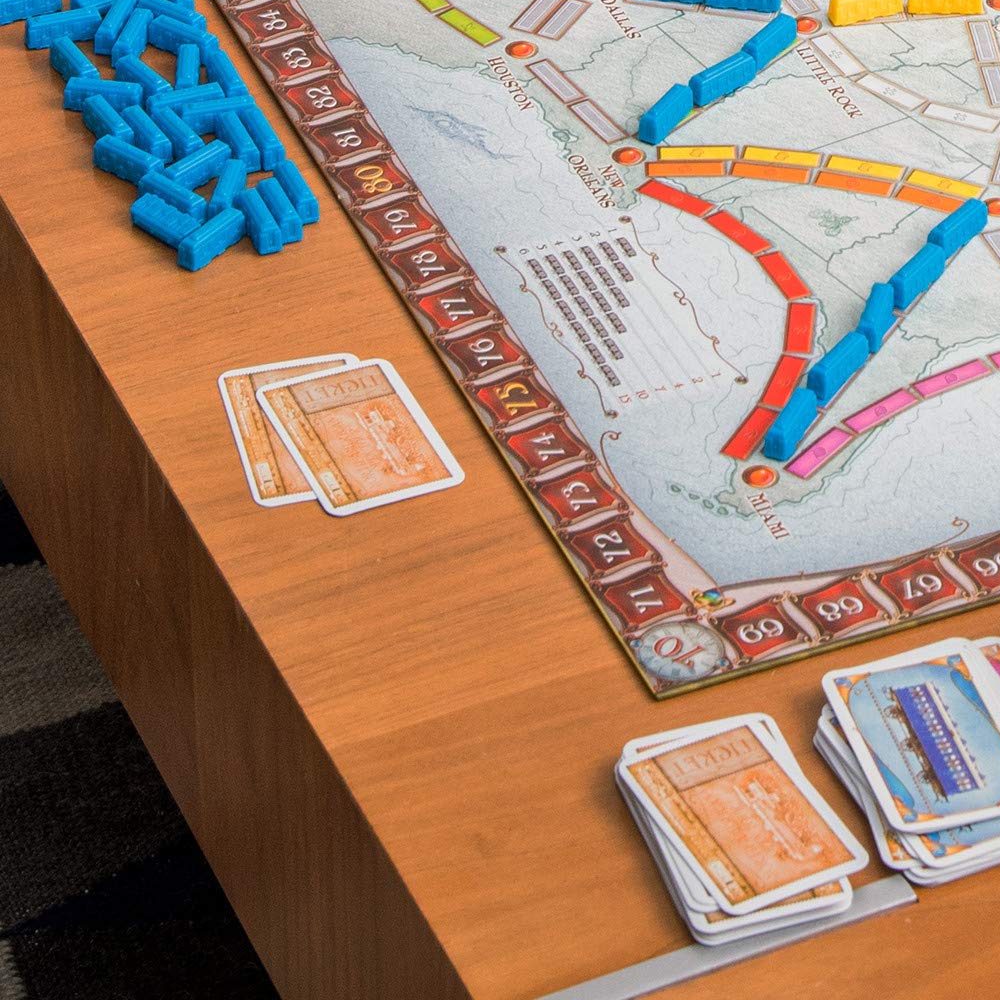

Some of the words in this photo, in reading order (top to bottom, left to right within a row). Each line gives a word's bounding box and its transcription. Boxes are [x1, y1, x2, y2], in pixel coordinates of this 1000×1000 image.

[257, 9, 288, 30] 84
[282, 47, 312, 69] 83
[306, 84, 337, 109] 82
[487, 56, 535, 112] HOUSTON
[796, 46, 836, 86] LITTLE
[828, 85, 864, 119] ROCK
[331, 128, 362, 148] 81
[354, 164, 392, 194] 80
[568, 155, 616, 208] ORLEANS
[598, 164, 625, 188] NEW
[384, 209, 417, 234] 79
[412, 250, 446, 277] 78
[440, 298, 474, 322] 77
[469, 338, 504, 367] 76
[304, 376, 382, 402] TICKET
[496, 382, 538, 416] 75
[532, 432, 564, 461] 74
[562, 481, 598, 511] 73
[746, 492, 790, 540] MIAMI
[594, 530, 631, 562] 72
[629, 585, 664, 614] 71
[903, 574, 942, 600] 67
[817, 596, 864, 621] 68
[738, 618, 784, 644] 69
[654, 636, 705, 669] 70
[672, 737, 756, 777] TICKET
